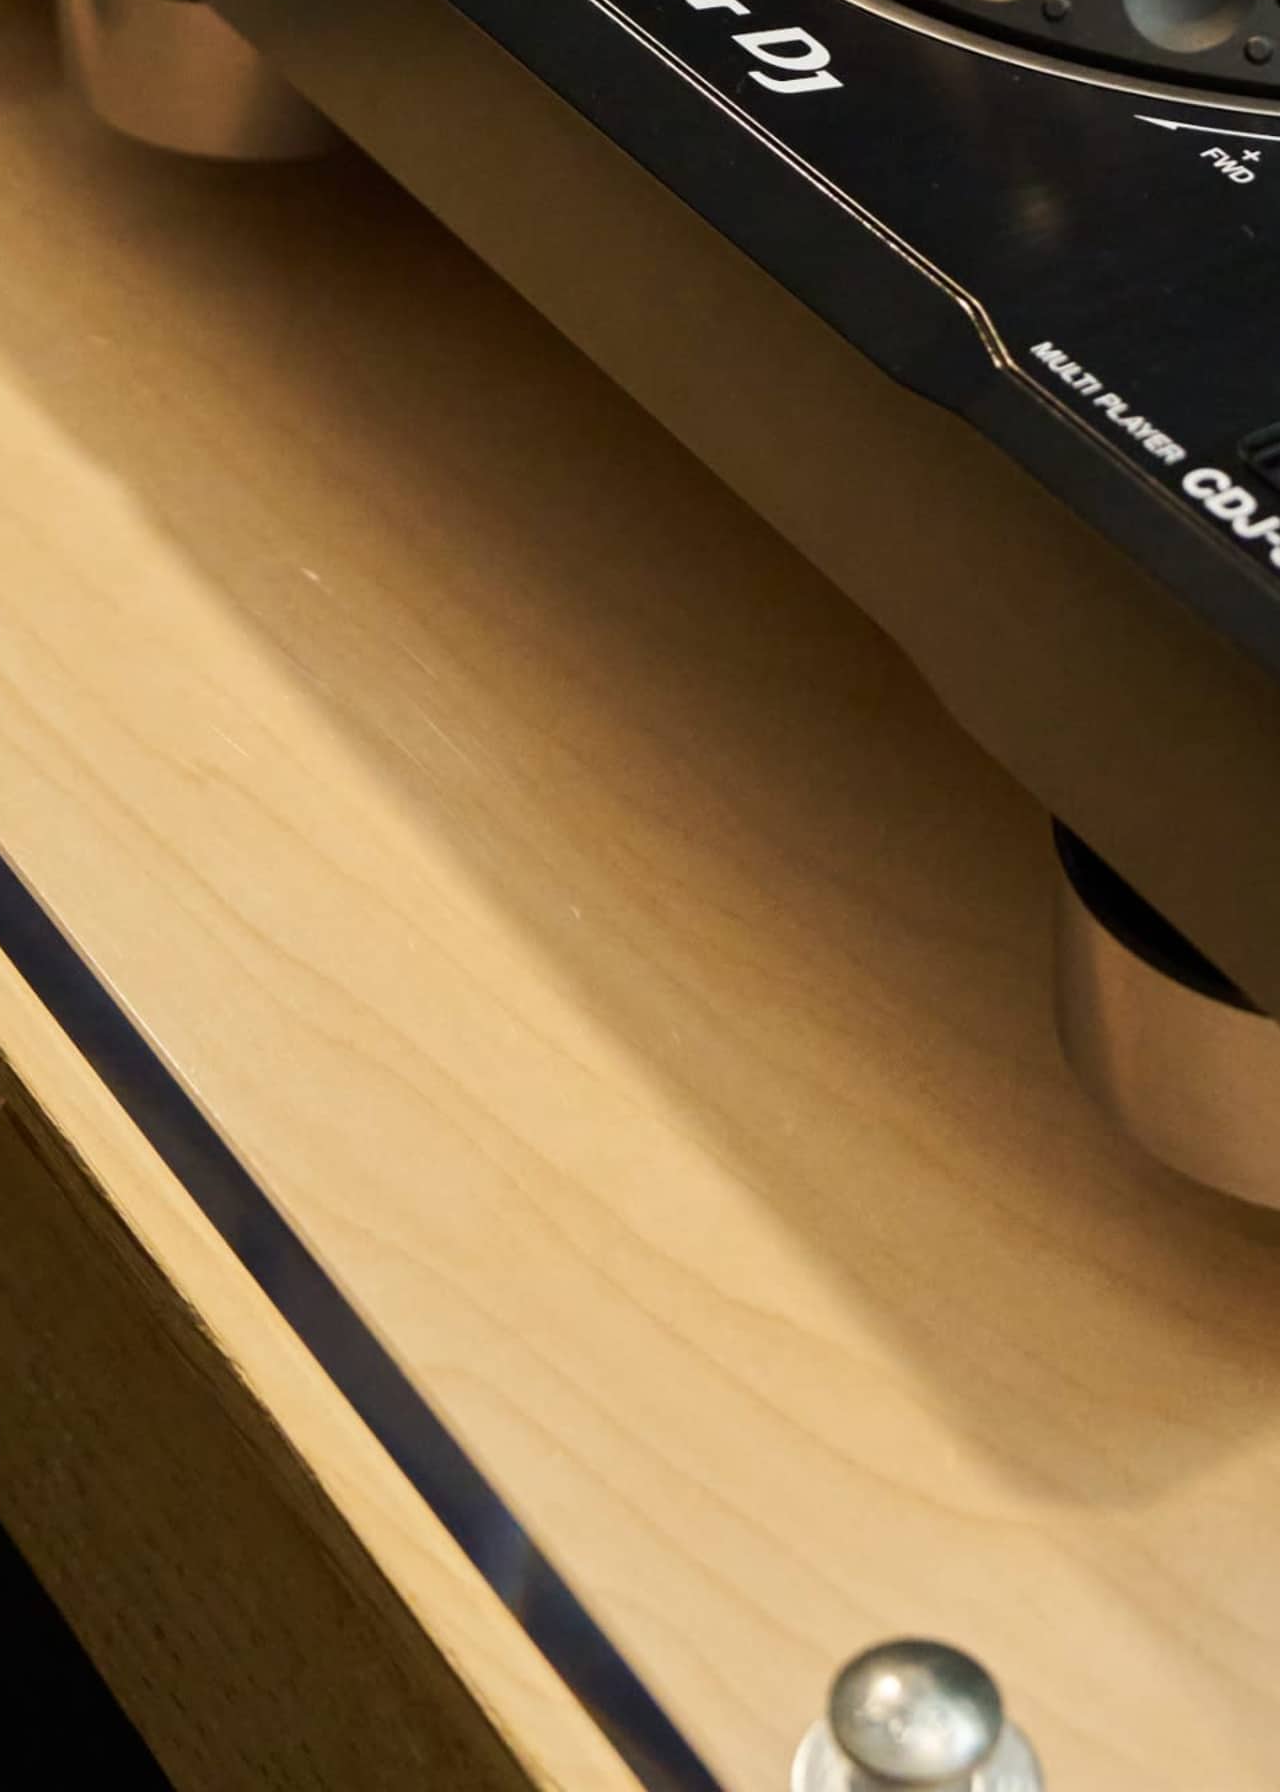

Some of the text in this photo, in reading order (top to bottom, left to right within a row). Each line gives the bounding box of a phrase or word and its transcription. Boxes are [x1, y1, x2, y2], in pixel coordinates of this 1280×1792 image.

[731, 27, 844, 94] DJ
[1200, 146, 1256, 185] FWD
[1030, 341, 1187, 466] MULTI PLAYER
